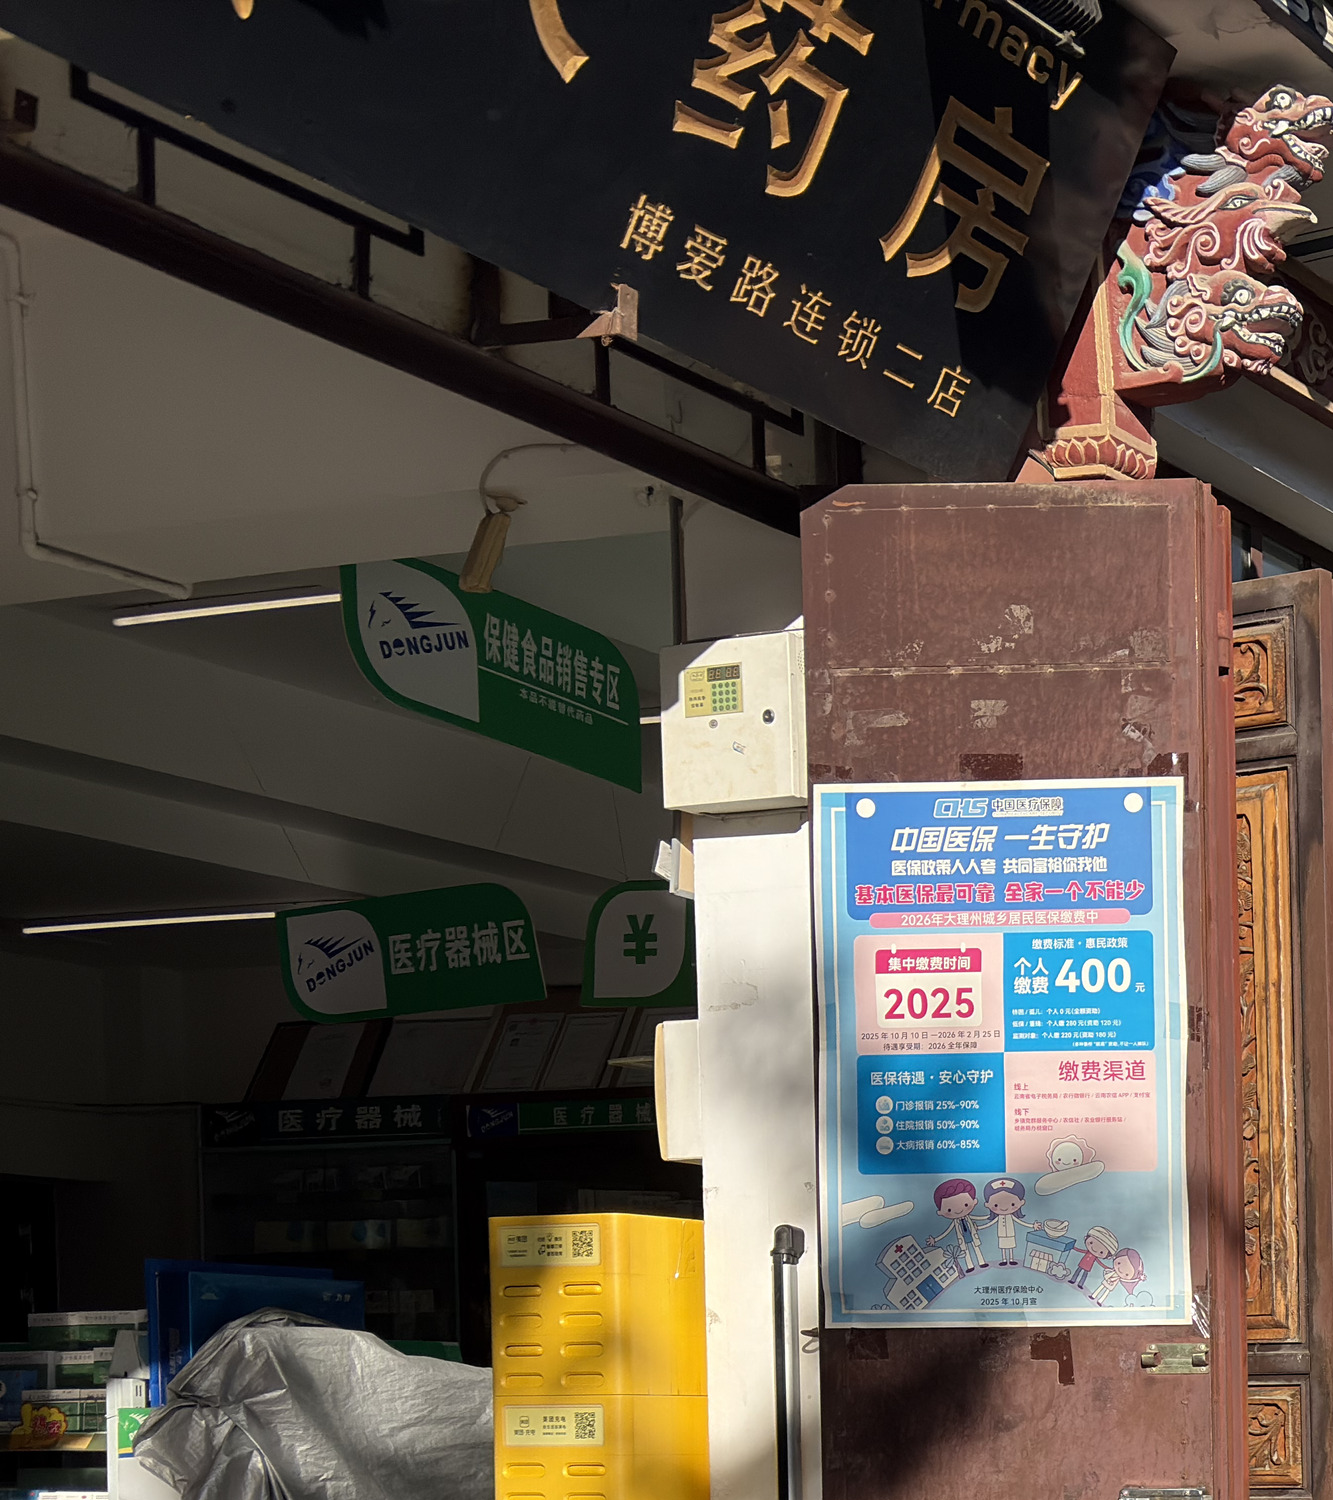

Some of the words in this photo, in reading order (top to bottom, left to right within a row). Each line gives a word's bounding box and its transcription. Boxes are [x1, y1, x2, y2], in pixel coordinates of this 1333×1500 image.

[933, 0, 1083, 110] macy
[528, 0, 1050, 313] 药房
[617, 193, 972, 419] 博爱路连锁二店
[378, 629, 470, 660] DONGJUN
[484, 612, 621, 711] 保健食品销售专区
[992, 797, 1063, 811] 中国医疗保障
[891, 825, 998, 853] 中国医保
[1004, 822, 1110, 850] 一生守护
[891, 859, 996, 876] 医保政策人人夸
[1003, 856, 1108, 874] 共同富裕你我他
[855, 882, 995, 905] 基本医保最可靠
[1004, 879, 1145, 902] 全家一个不能少
[901, 911, 1099, 926] 2026年大理州城乡居民医保缴费中
[389, 919, 531, 976] 医疗器械区
[888, 956, 971, 972] 集中缴费时间
[1013, 957, 1049, 975] 个人
[1013, 976, 1049, 994] 缴费
[1055, 957, 1131, 993] 400
[1135, 982, 1145, 993] 元
[884, 987, 975, 1020] 2025
[1058, 1060, 1146, 1081] 缴费渠道
[895, 1101, 934, 1111] 门诊报销
[936, 1100, 980, 1110] 25%-90%
[277, 1104, 423, 1134] 医疗器械
[936, 1120, 980, 1130] 50%-90%
[936, 1140, 980, 1149] 60%-85%
[974, 1285, 1044, 1296] 大理州医疗保险中心
